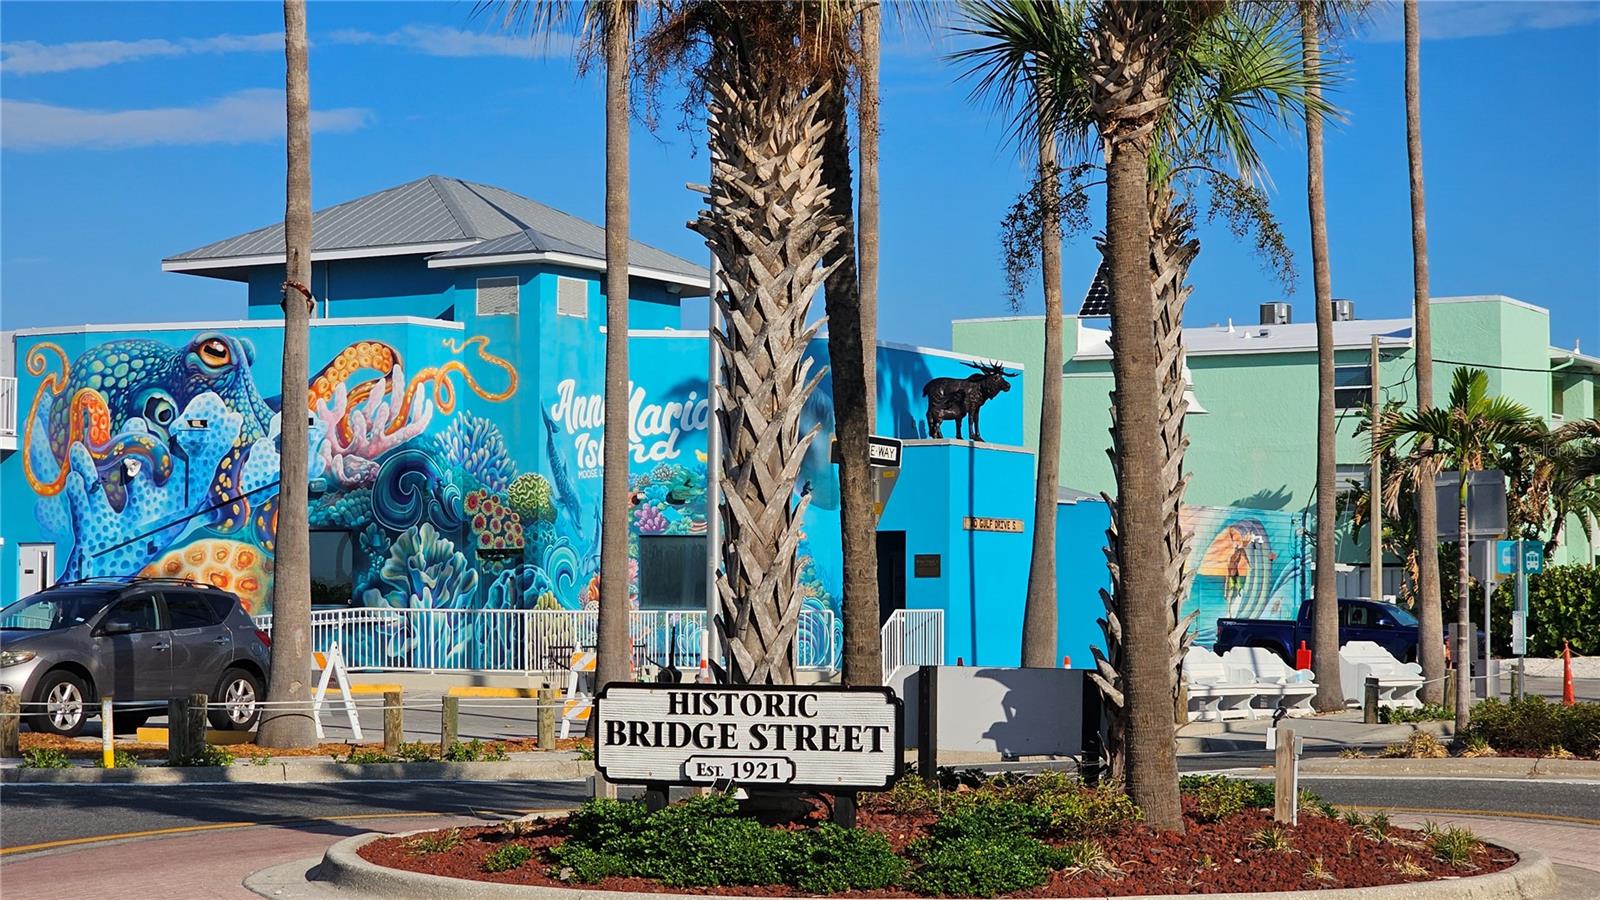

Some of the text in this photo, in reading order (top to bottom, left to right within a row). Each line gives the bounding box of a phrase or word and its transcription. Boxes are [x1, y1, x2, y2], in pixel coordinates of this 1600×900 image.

[552, 378, 605, 434] Ann
[575, 428, 680, 468] Isnd
[667, 692, 819, 719] HISTORIC
[604, 720, 890, 753] BRIDGE STREET
[731, 762, 780, 780] 1921
